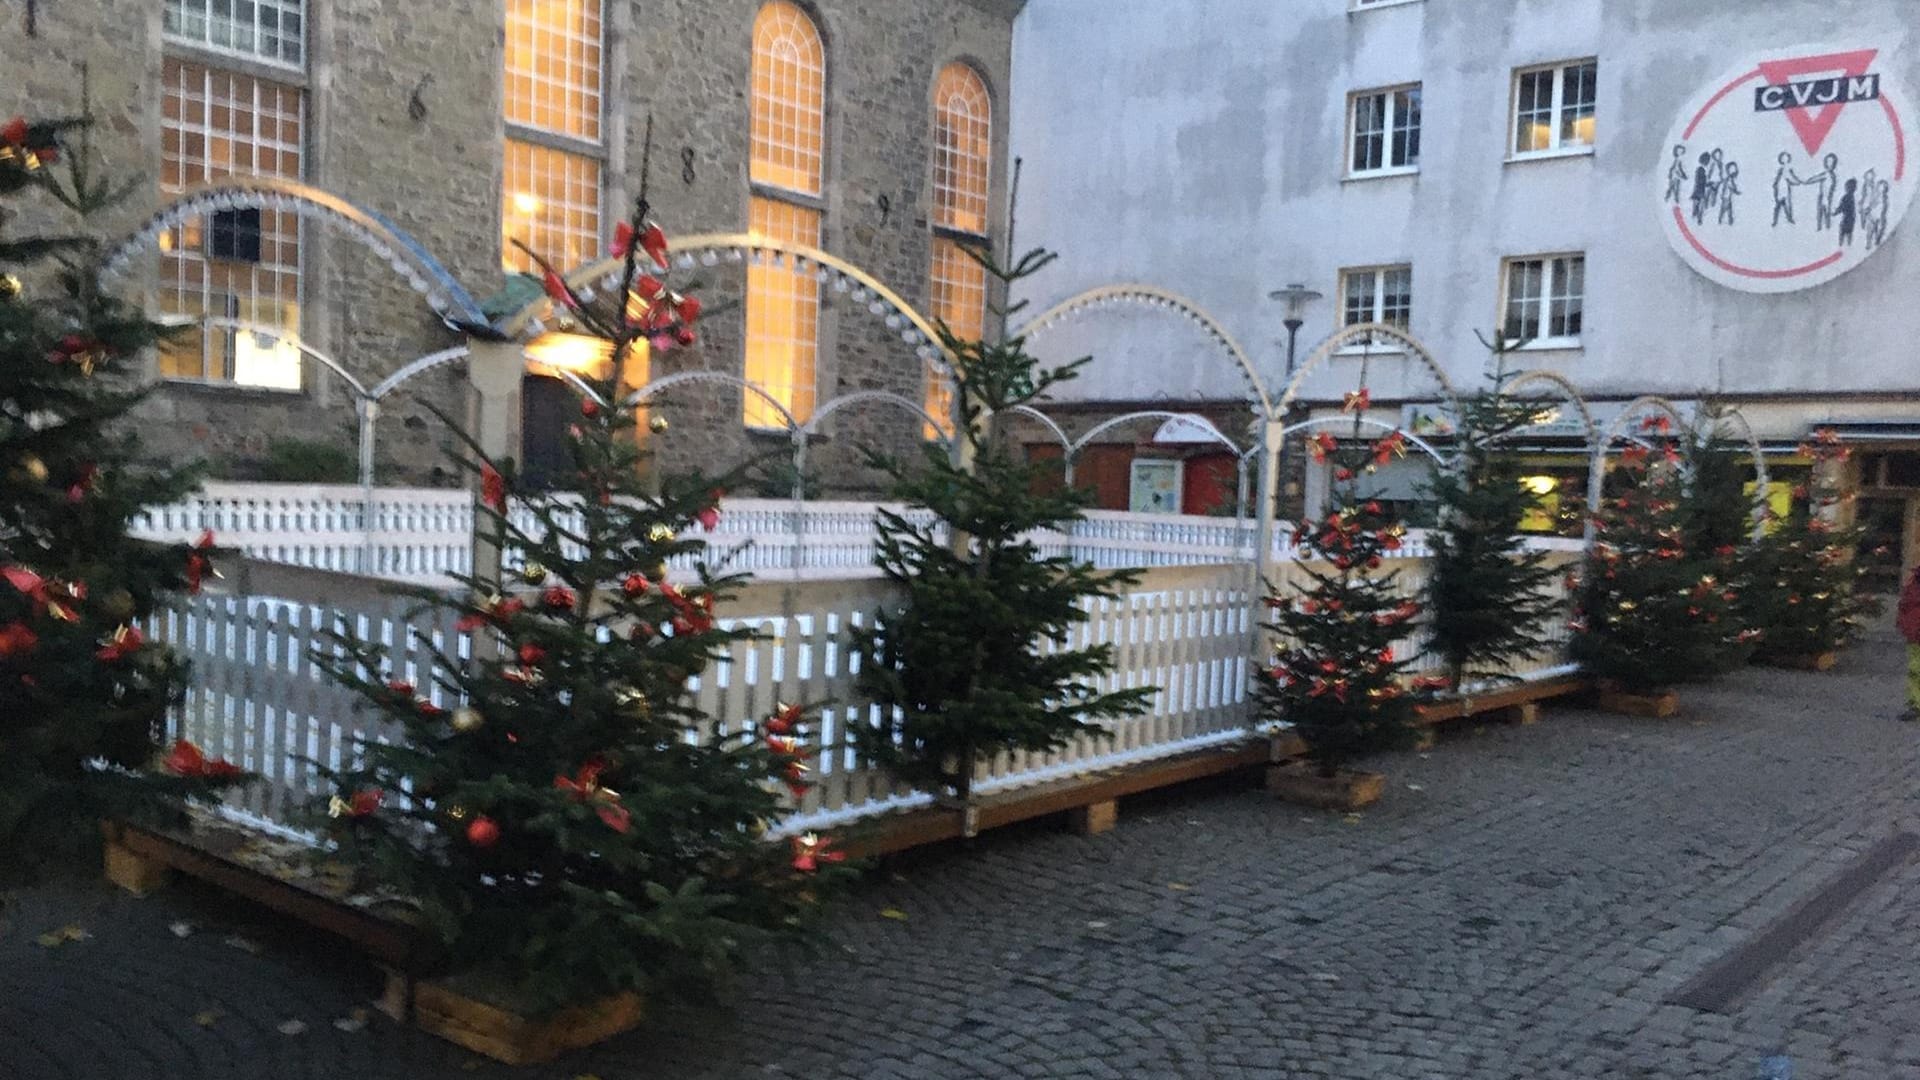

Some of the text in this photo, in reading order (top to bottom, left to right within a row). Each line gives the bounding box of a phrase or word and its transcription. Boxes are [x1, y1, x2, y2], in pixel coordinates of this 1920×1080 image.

[1760, 76, 1874, 109] CVJM
[681, 146, 696, 185] 8
[878, 194, 890, 228] 9
